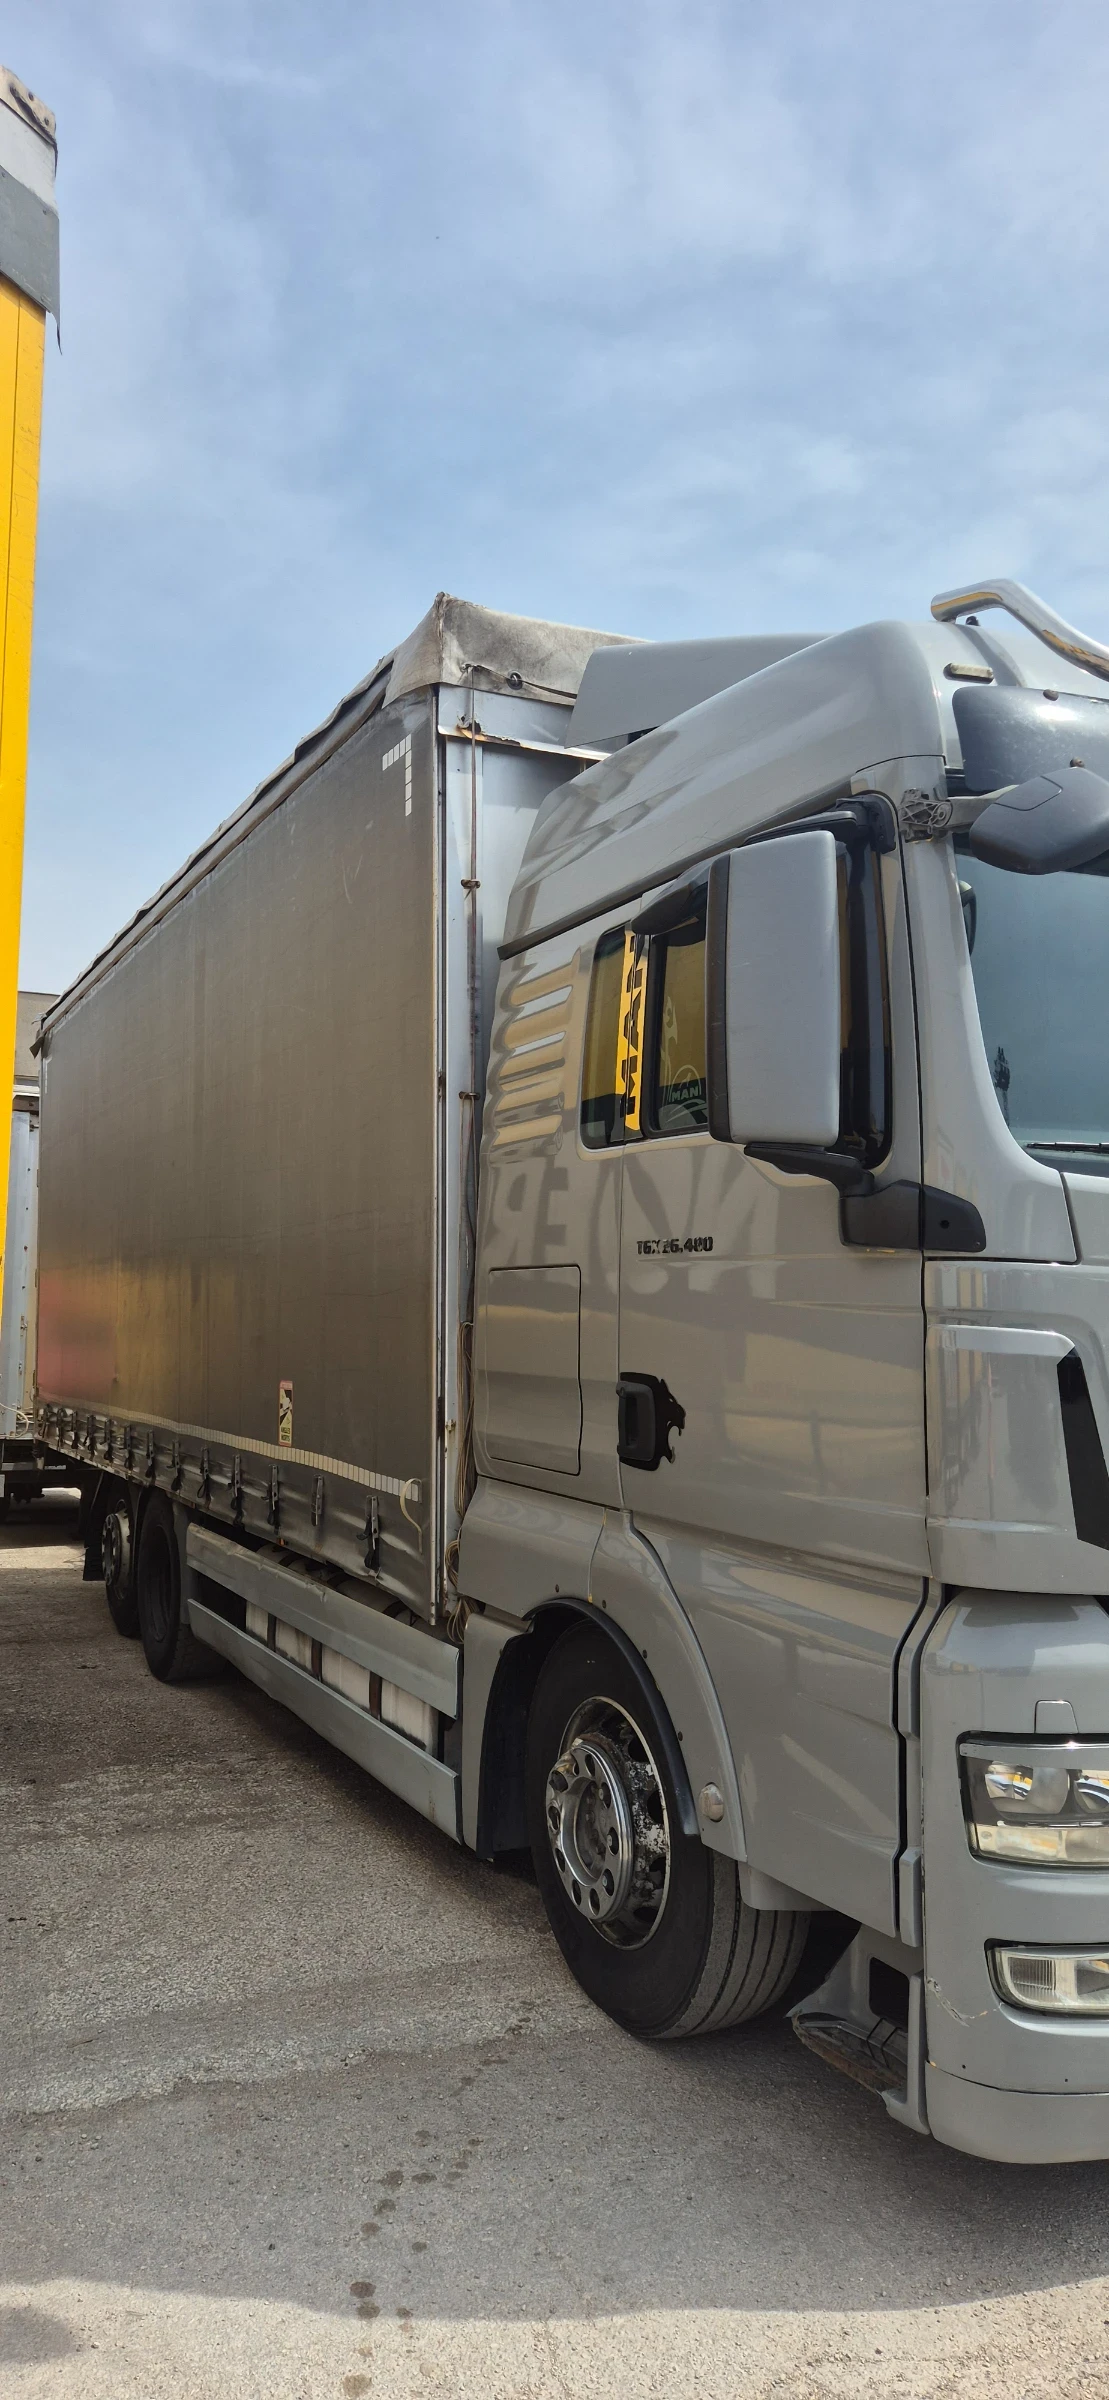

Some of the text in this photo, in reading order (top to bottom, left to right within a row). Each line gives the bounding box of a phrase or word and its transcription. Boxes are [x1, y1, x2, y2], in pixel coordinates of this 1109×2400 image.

[620, 935, 643, 1118] MAN
[672, 1085, 699, 1102] MAN
[636, 1239, 660, 1255] TGX
